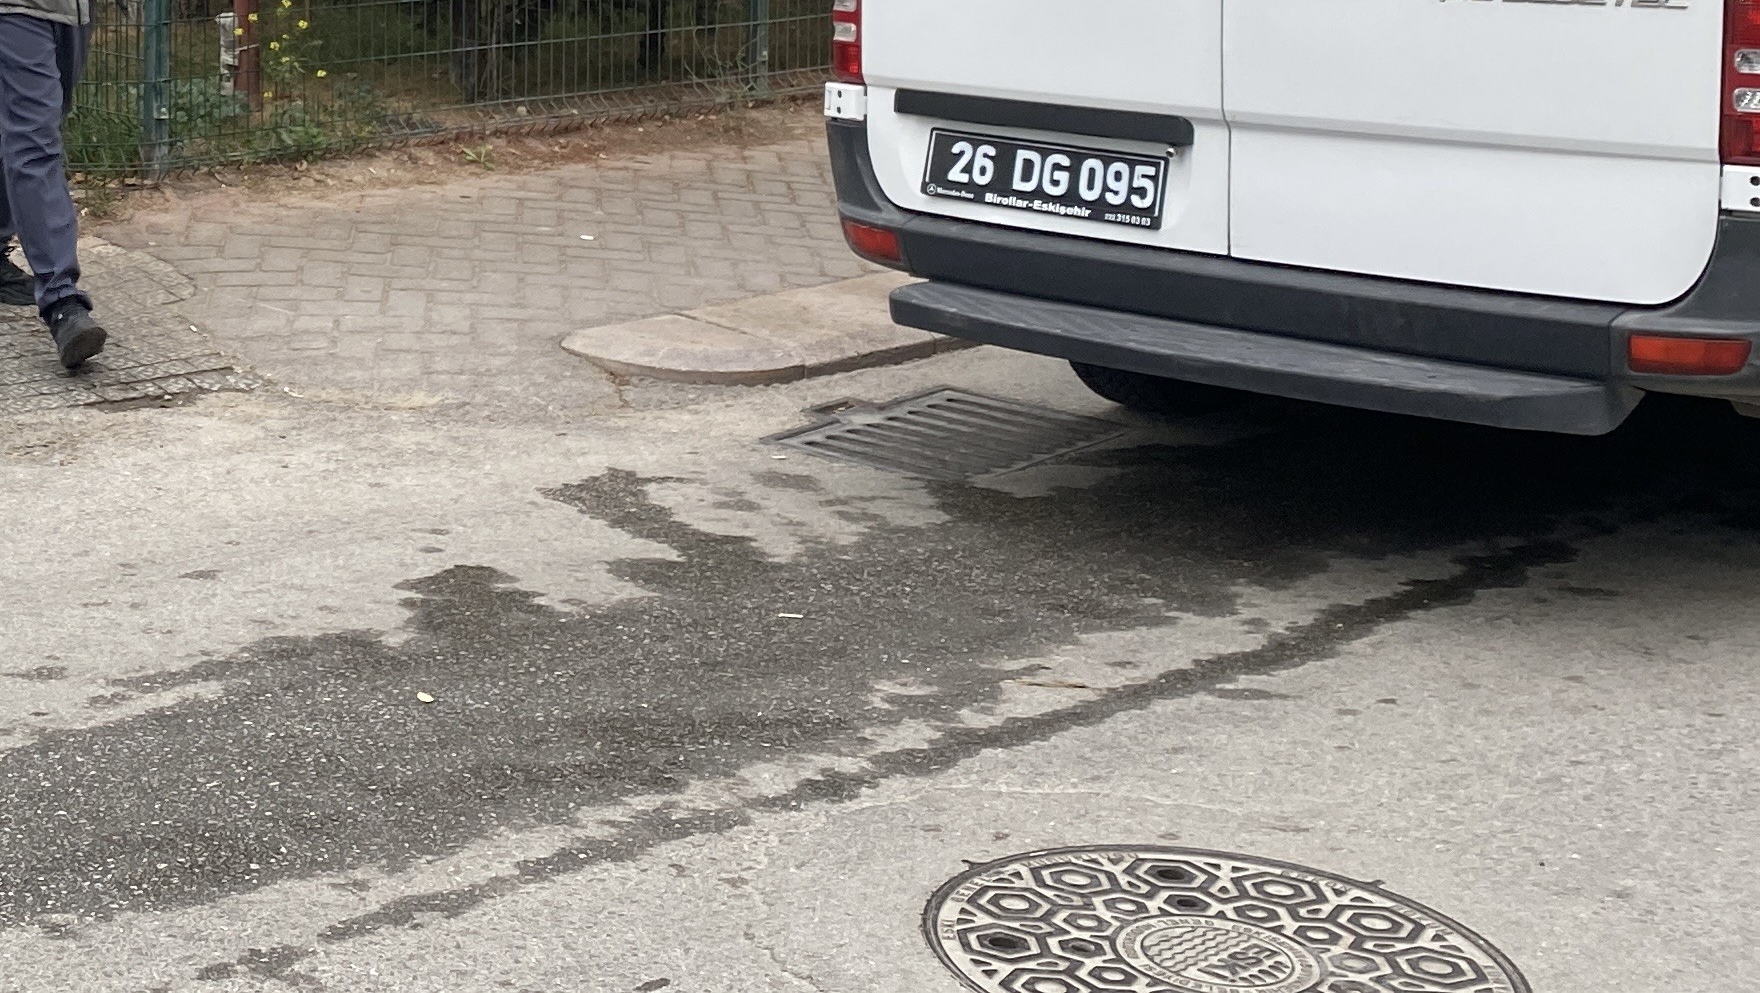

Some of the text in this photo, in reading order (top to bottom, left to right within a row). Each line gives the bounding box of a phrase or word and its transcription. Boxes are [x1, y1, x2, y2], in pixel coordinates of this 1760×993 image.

[946, 140, 1157, 210] 26 DG 095
